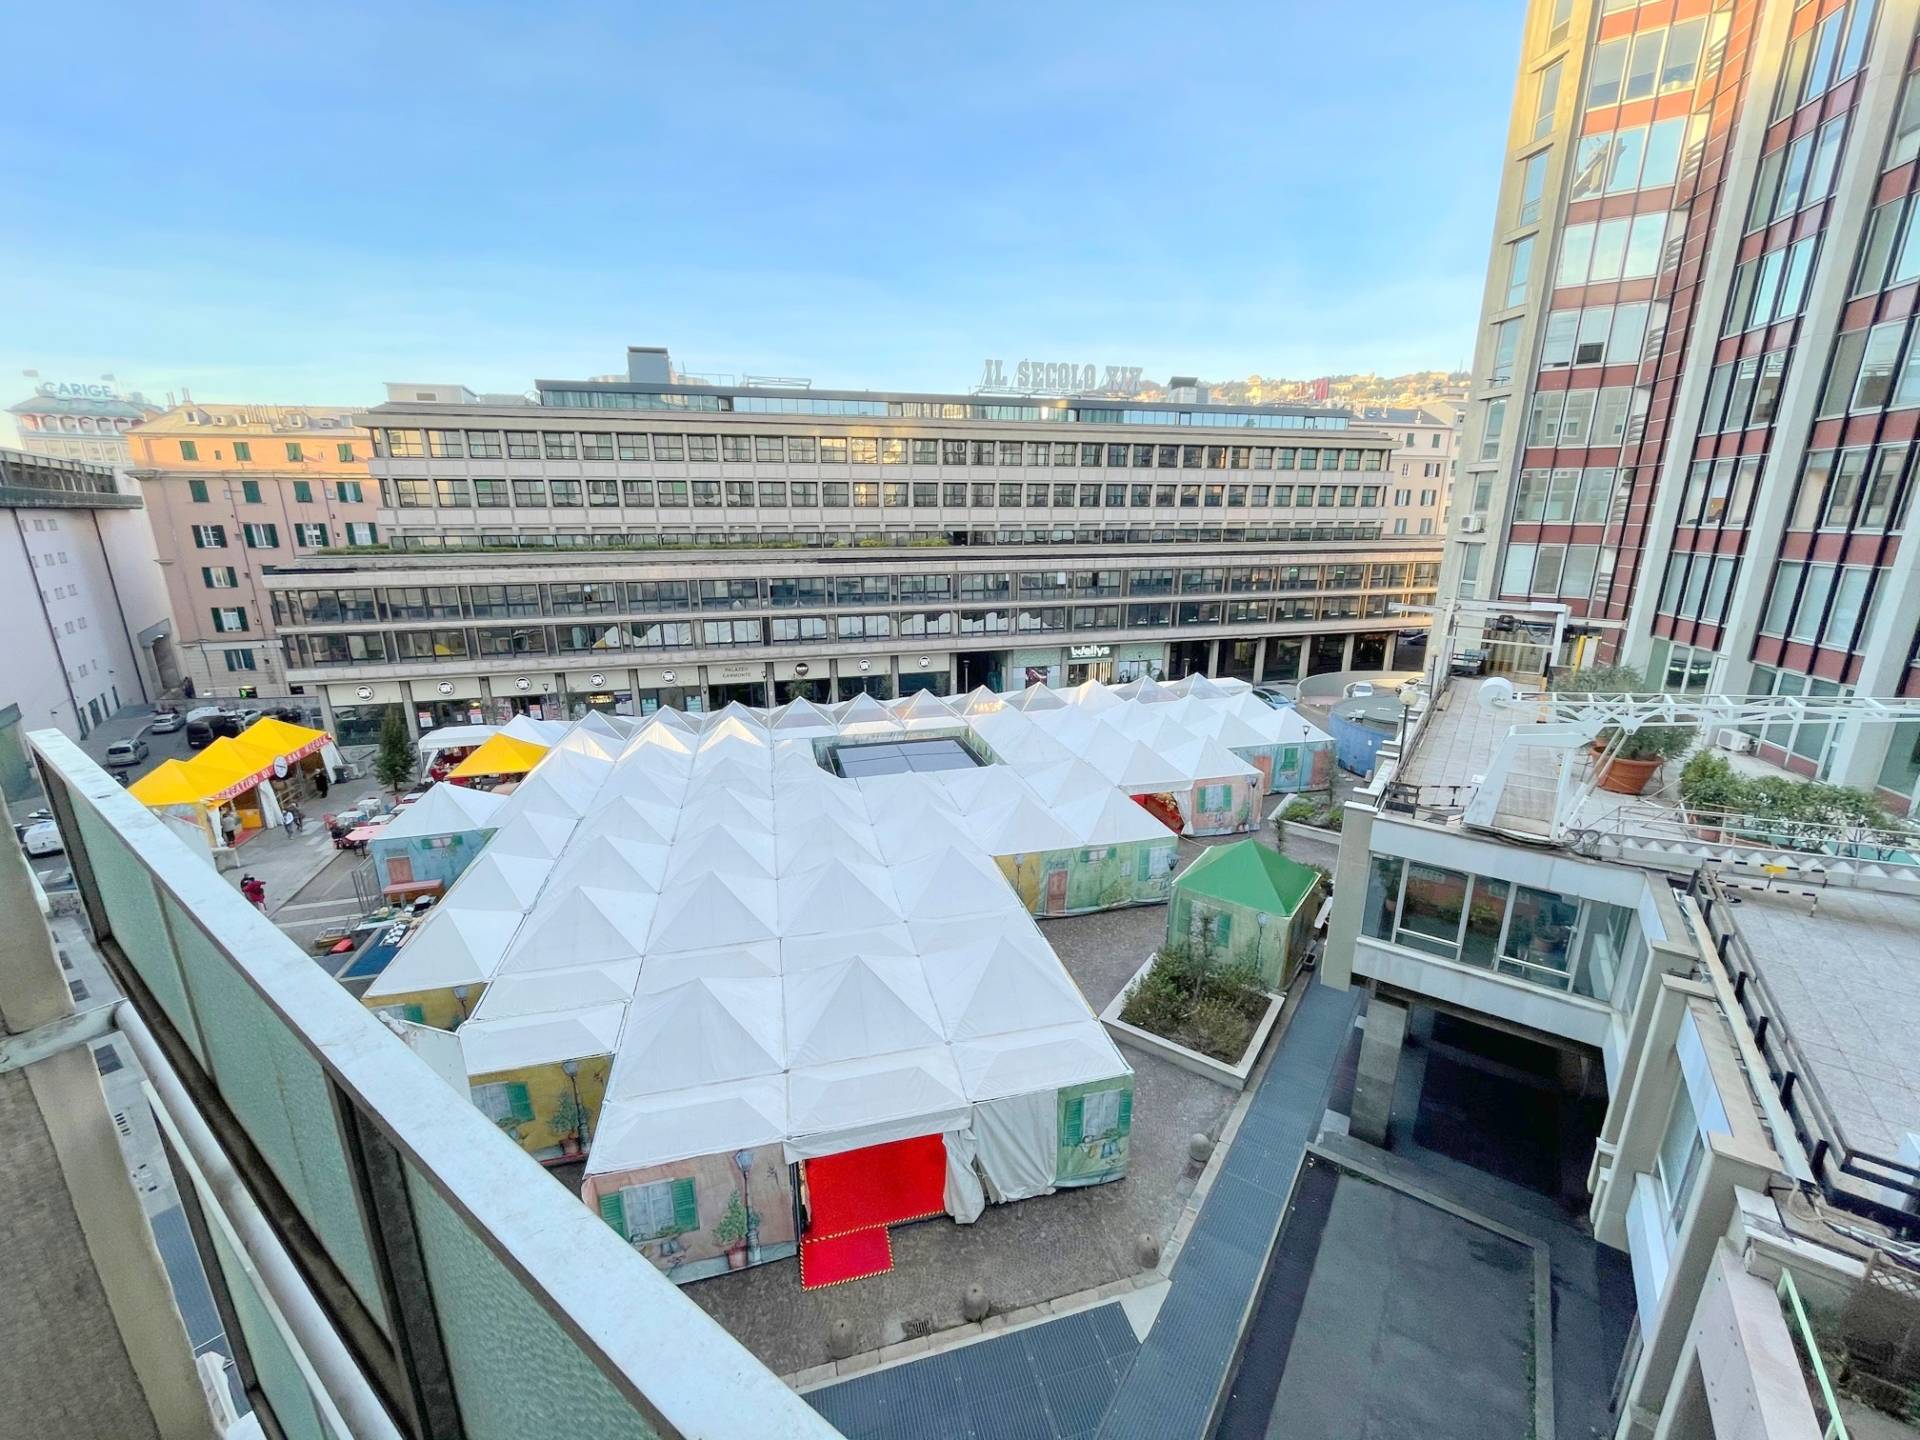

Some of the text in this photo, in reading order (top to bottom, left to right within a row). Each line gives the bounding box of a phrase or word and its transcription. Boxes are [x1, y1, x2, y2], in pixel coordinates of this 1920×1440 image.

[985, 359, 1143, 393] IL SECOLO XIX
[43, 382, 112, 397] CARIGE
